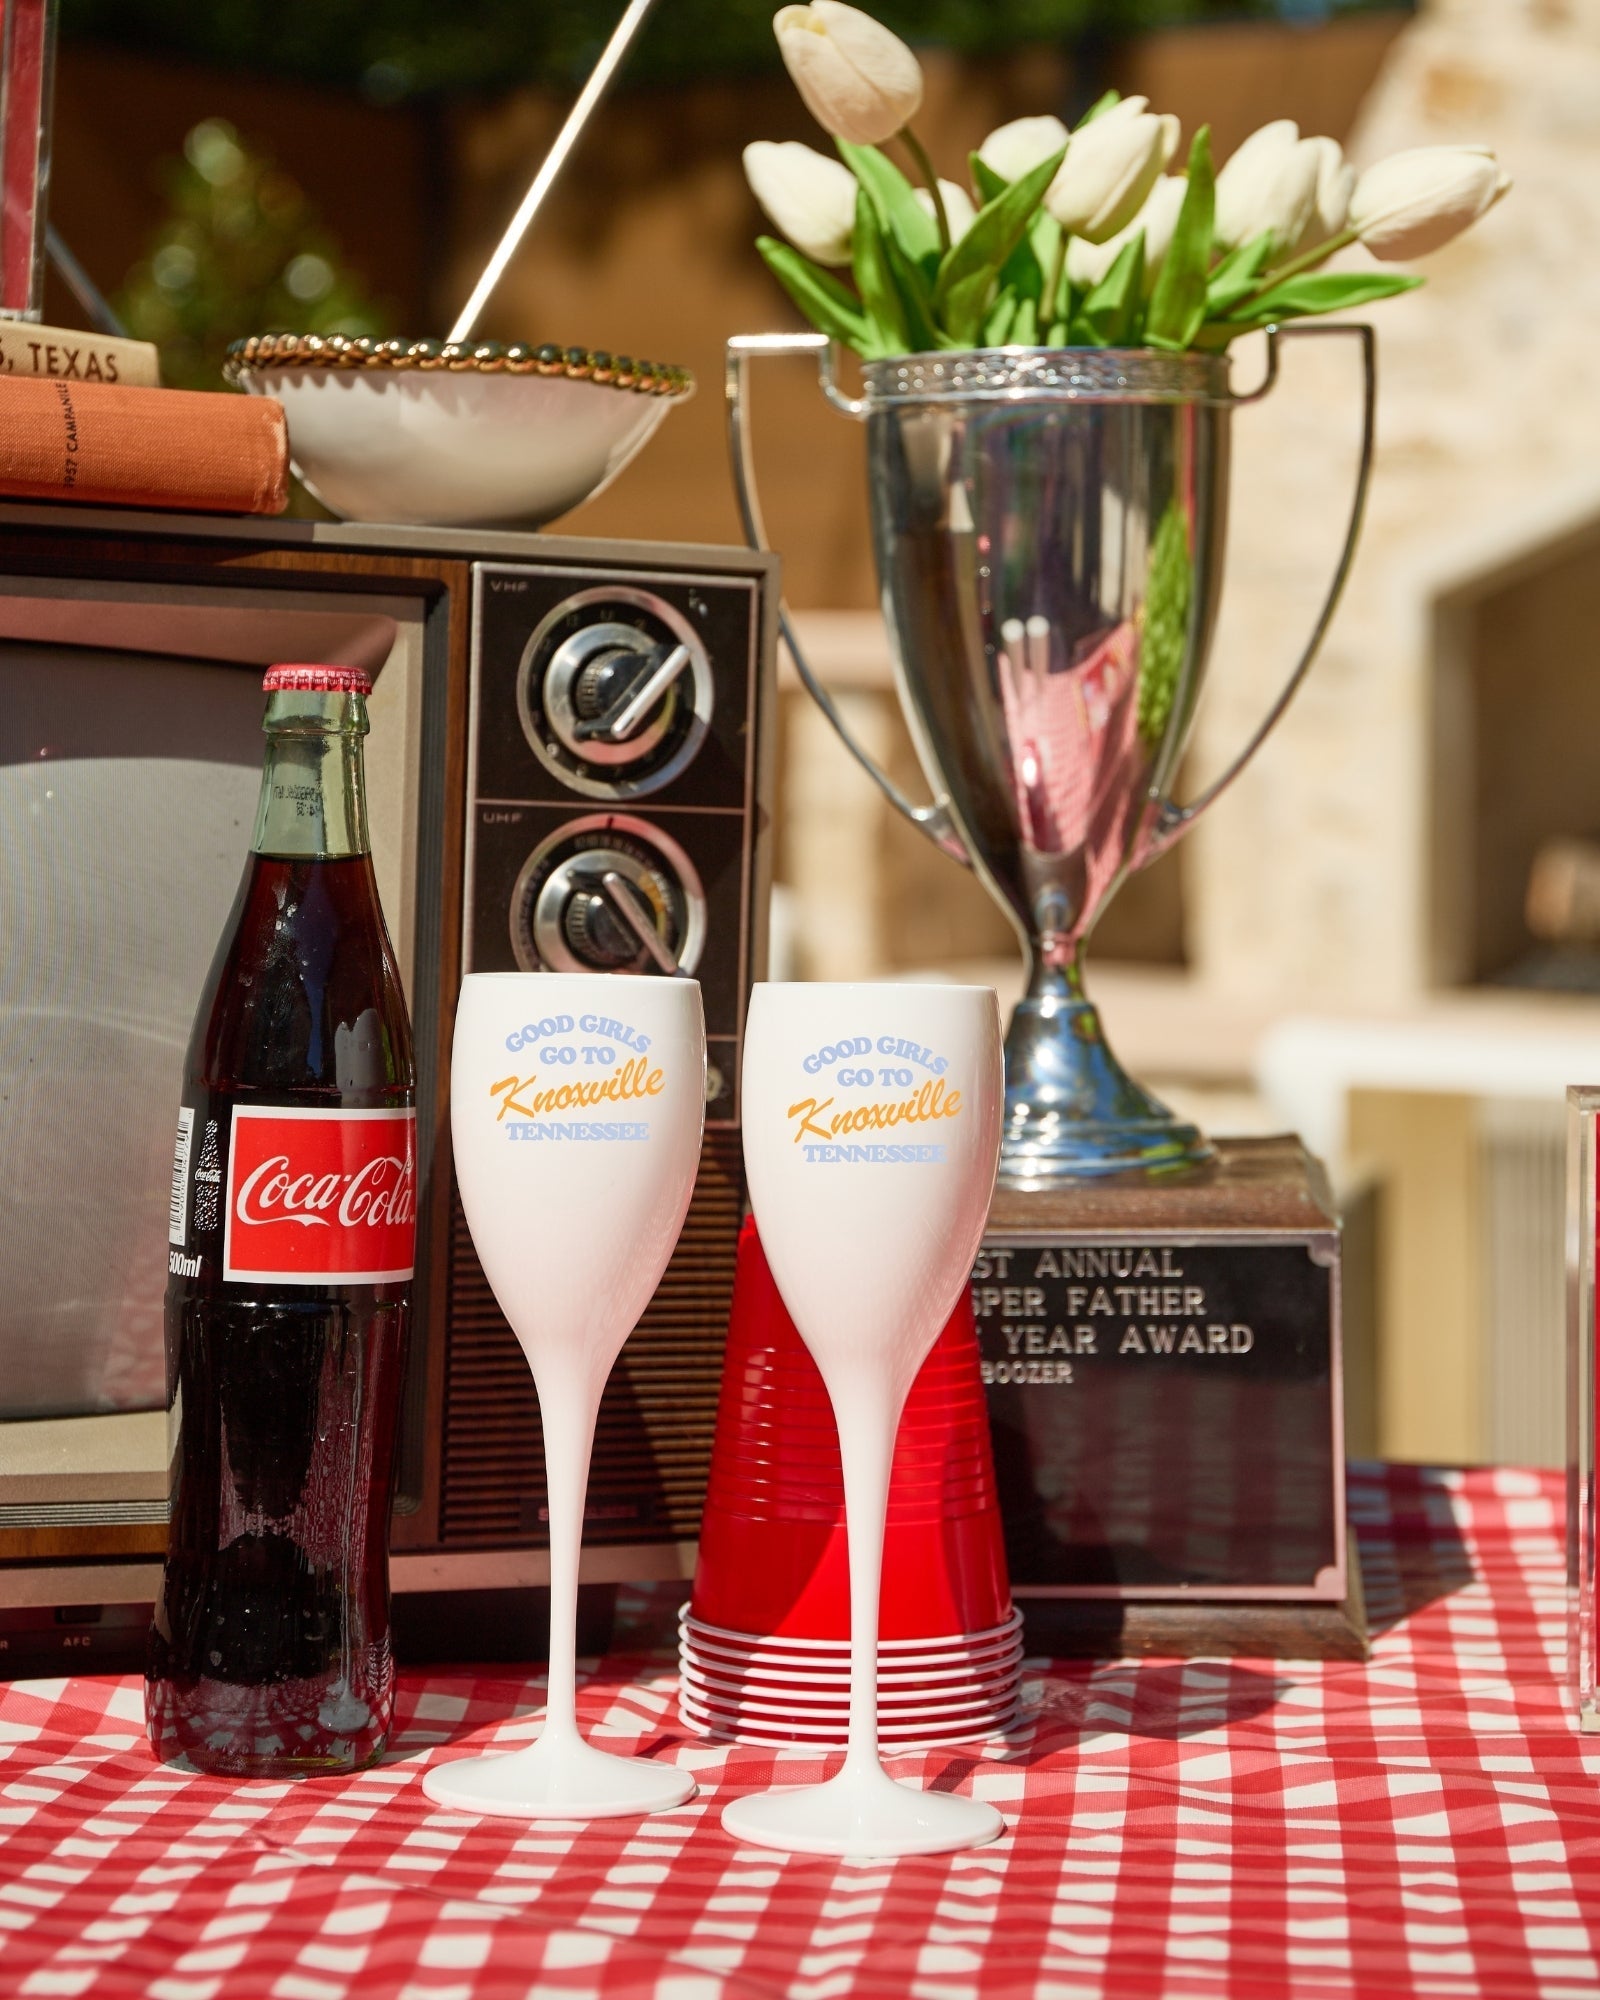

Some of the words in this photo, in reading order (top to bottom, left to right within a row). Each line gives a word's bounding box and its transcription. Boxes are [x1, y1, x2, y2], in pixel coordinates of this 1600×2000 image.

[27, 342, 119, 383] TEXAS
[56, 382, 79, 453] CAMPANILE
[490, 580, 529, 592] VHF
[482, 812, 523, 824] UHF
[505, 1014, 575, 1053] GOOD
[579, 1014, 652, 1054] GIRLS
[539, 1046, 577, 1065] GO
[580, 1046, 616, 1065] TO
[802, 1036, 873, 1075] GOOD
[876, 1035, 949, 1076] GIRLS
[490, 1056, 666, 1121] Knoxville
[836, 1068, 875, 1087] GO
[878, 1068, 914, 1087] TO
[788, 1078, 963, 1143] Knoxville
[505, 1122, 651, 1141] TENNESSEE
[802, 1144, 949, 1163] TENNESSEE
[236, 1155, 414, 1227] Coca-Cola
[169, 1251, 202, 1278] 500ml
[1034, 1248, 1184, 1278] ANNUAL
[1066, 1286, 1208, 1316] FATHER
[1001, 1324, 1099, 1354] YEAR
[1119, 1324, 1255, 1354] AWARD
[980, 1360, 1075, 1384] BOOZER
[62, 1636, 91, 1647] AFC
